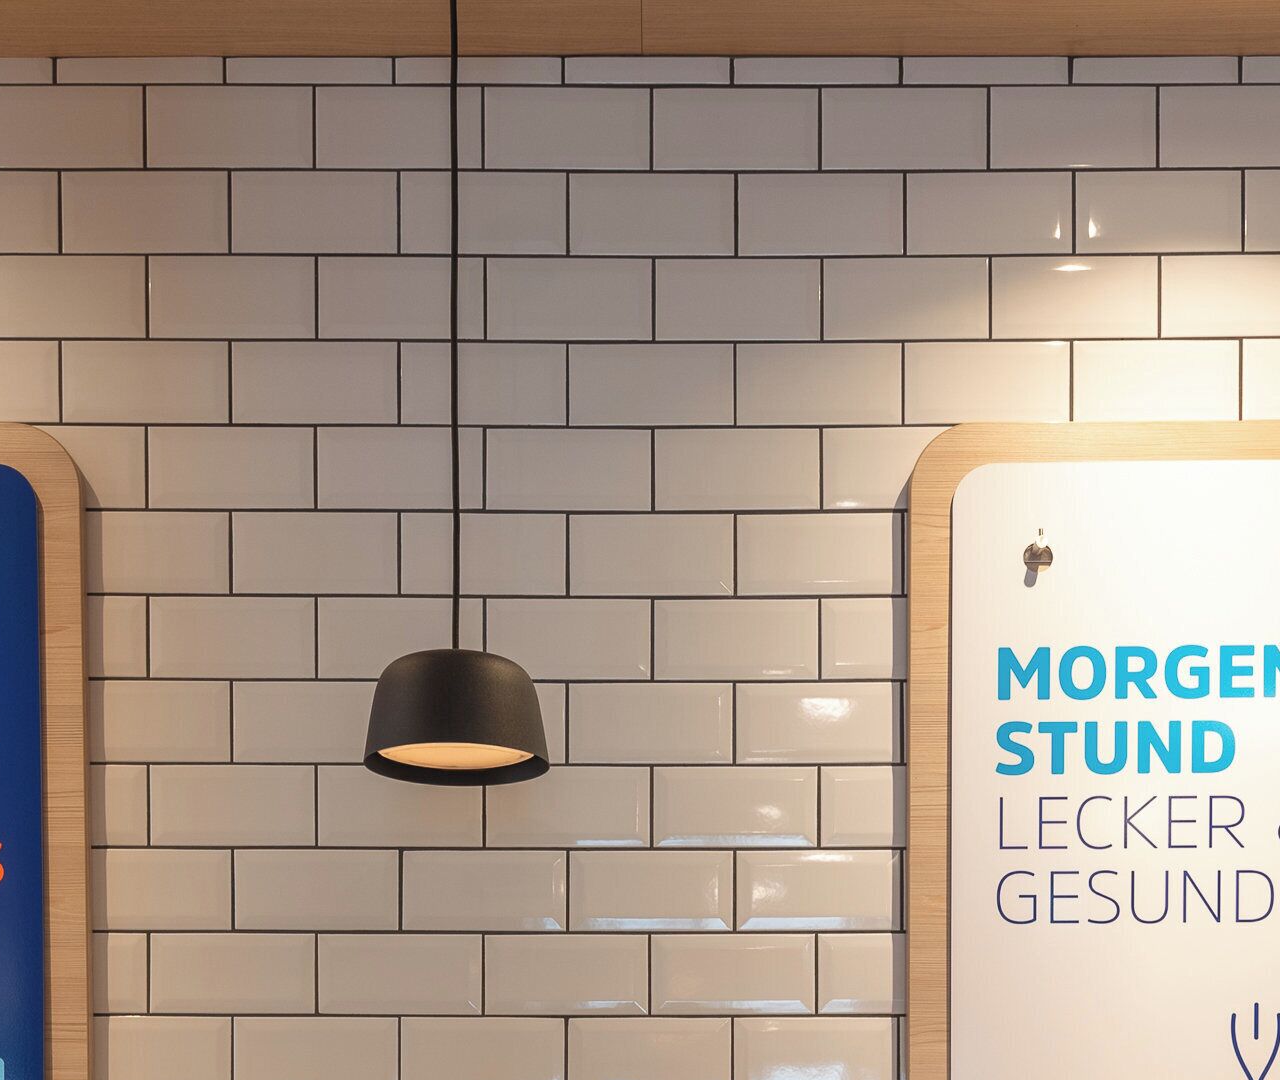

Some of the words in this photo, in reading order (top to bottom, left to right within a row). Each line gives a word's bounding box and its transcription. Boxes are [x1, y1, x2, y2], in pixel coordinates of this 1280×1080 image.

[995, 719, 1236, 777] STUND
[999, 794, 1246, 850] LECKER
[995, 869, 1275, 926] GESUND
